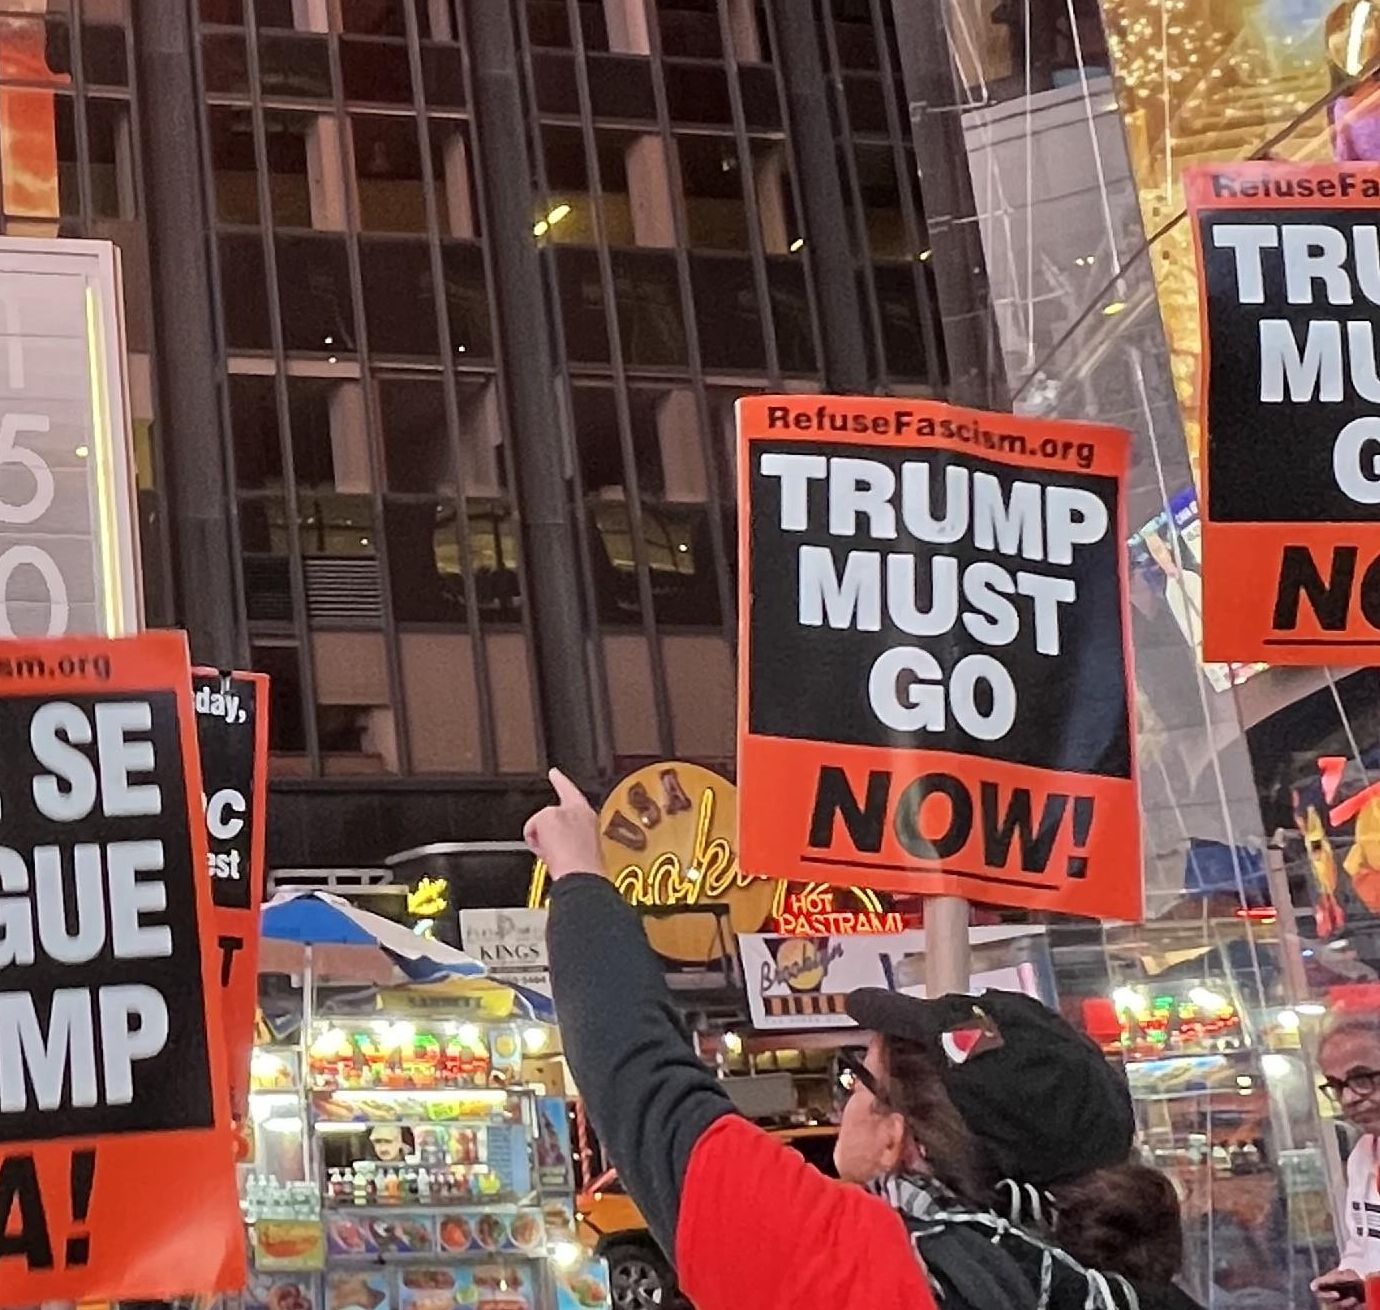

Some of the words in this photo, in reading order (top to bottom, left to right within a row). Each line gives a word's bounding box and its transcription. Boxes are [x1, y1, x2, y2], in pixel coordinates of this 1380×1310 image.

[767, 405, 1096, 469] RefuseFascism.org
[759, 452, 1109, 567] TRUMP
[798, 545, 1076, 656] MUST
[868, 645, 1017, 742] GO
[29, 701, 163, 823] SE
[604, 768, 692, 851] USA
[807, 763, 1096, 879] NOW!
[778, 912, 904, 936] PASTRAMI
[791, 893, 834, 915] HOT
[480, 943, 541, 962] KINGS
